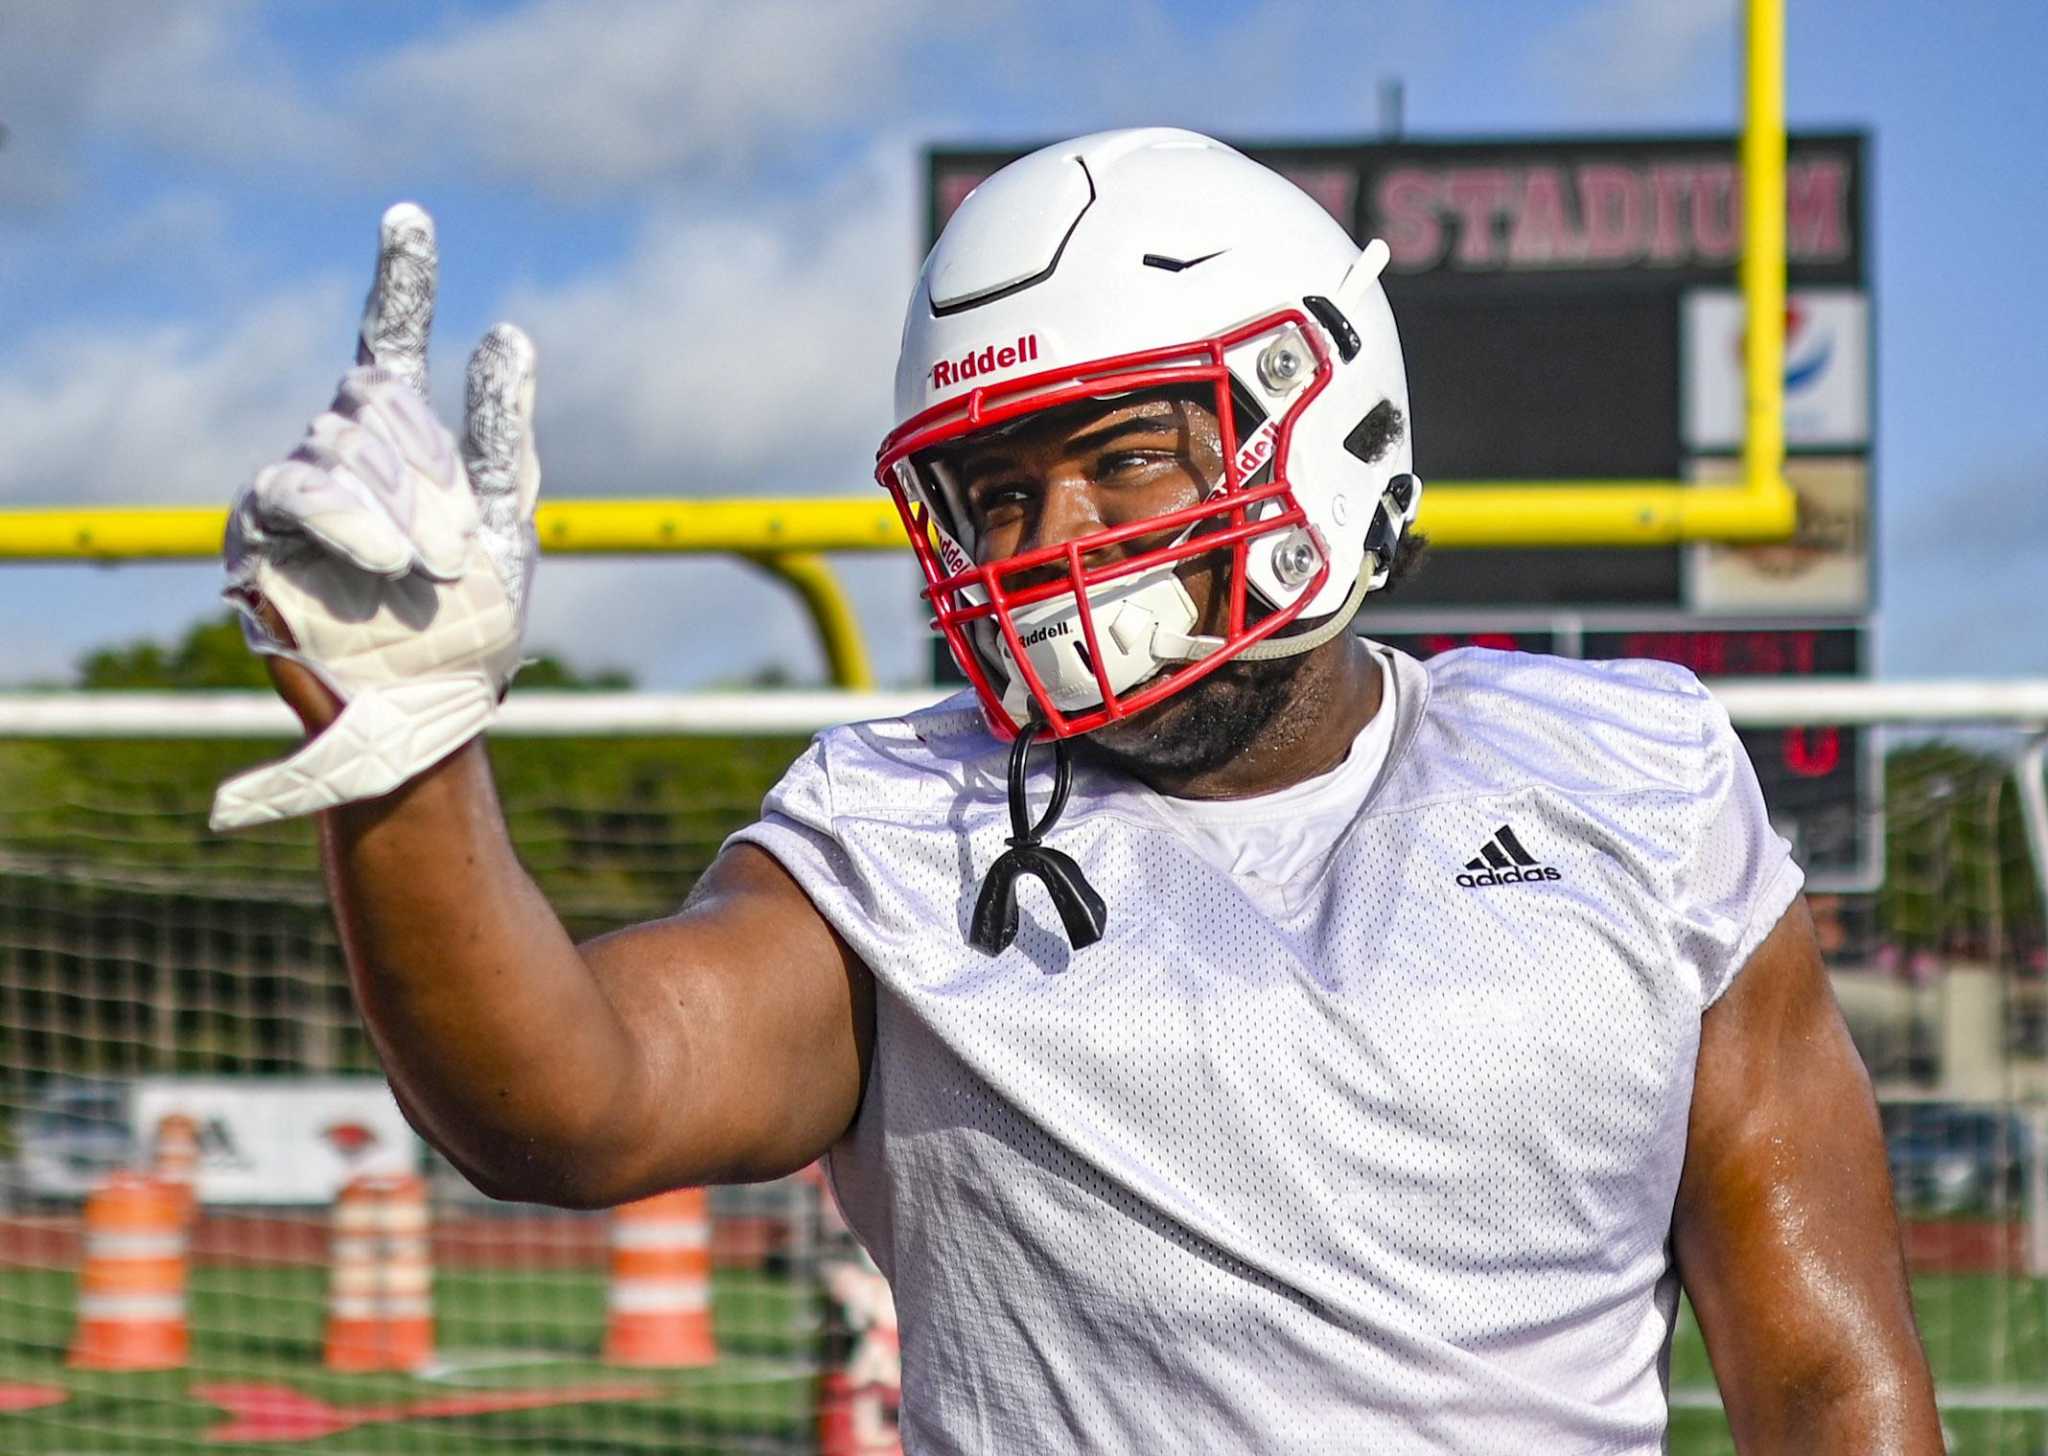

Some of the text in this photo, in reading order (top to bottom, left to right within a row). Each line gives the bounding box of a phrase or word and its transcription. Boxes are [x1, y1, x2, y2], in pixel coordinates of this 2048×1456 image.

[1376, 158, 1850, 272] STADIUM
[934, 334, 1038, 389] Riddell
[1456, 865, 1562, 888] adidas
